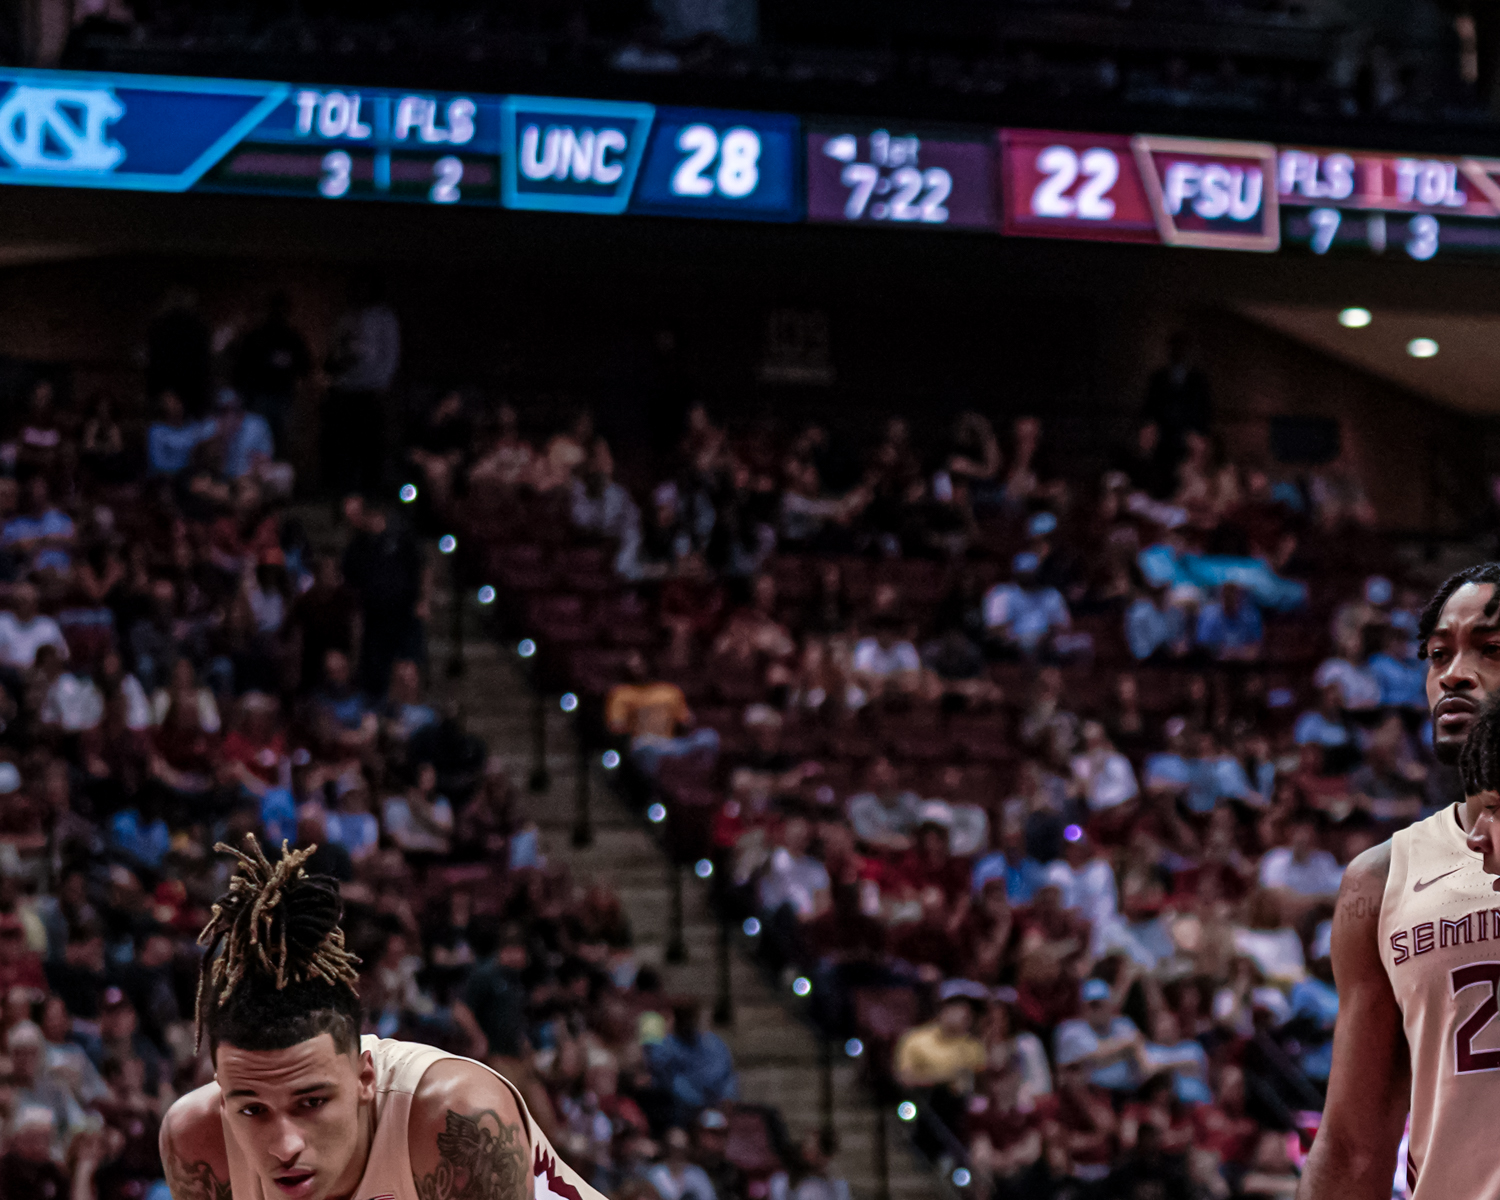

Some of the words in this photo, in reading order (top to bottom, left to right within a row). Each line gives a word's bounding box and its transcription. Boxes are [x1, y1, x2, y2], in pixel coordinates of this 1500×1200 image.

[296, 89, 372, 139] TOL
[395, 94, 477, 145] FLS
[318, 150, 351, 199] 3
[429, 155, 463, 204] 2
[520, 123, 627, 184] UNC
[672, 122, 761, 198] 28
[1031, 145, 1119, 220] 22
[1278, 150, 1355, 199] FLS
[1396, 157, 1468, 207] TOL
[841, 162, 952, 223] 7:22
[1163, 161, 1263, 222] FSU
[1308, 207, 1342, 255] 7
[1405, 214, 1439, 261] 3
